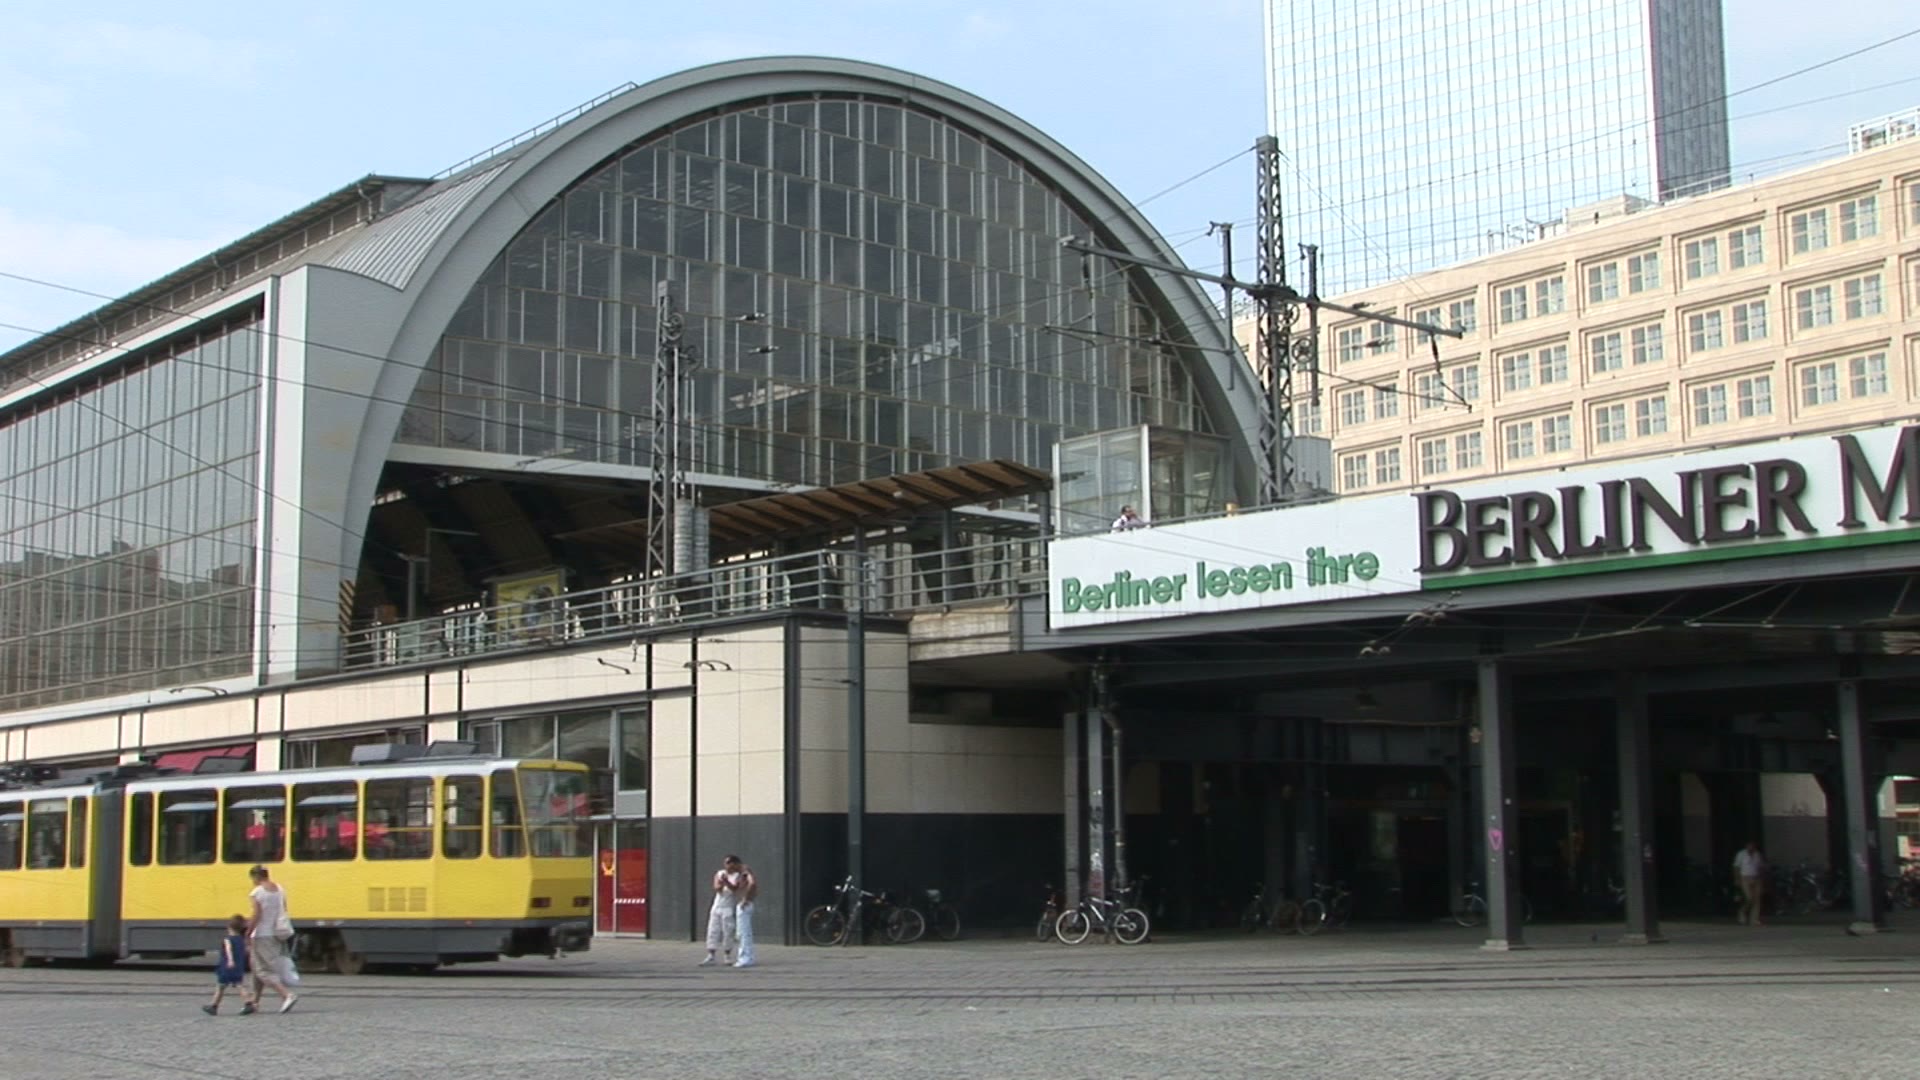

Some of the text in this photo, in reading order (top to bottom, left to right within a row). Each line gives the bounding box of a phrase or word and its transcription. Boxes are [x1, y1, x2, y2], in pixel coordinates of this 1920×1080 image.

[1062, 427, 1920, 613] Berliner lesen ihre BERLINER M
